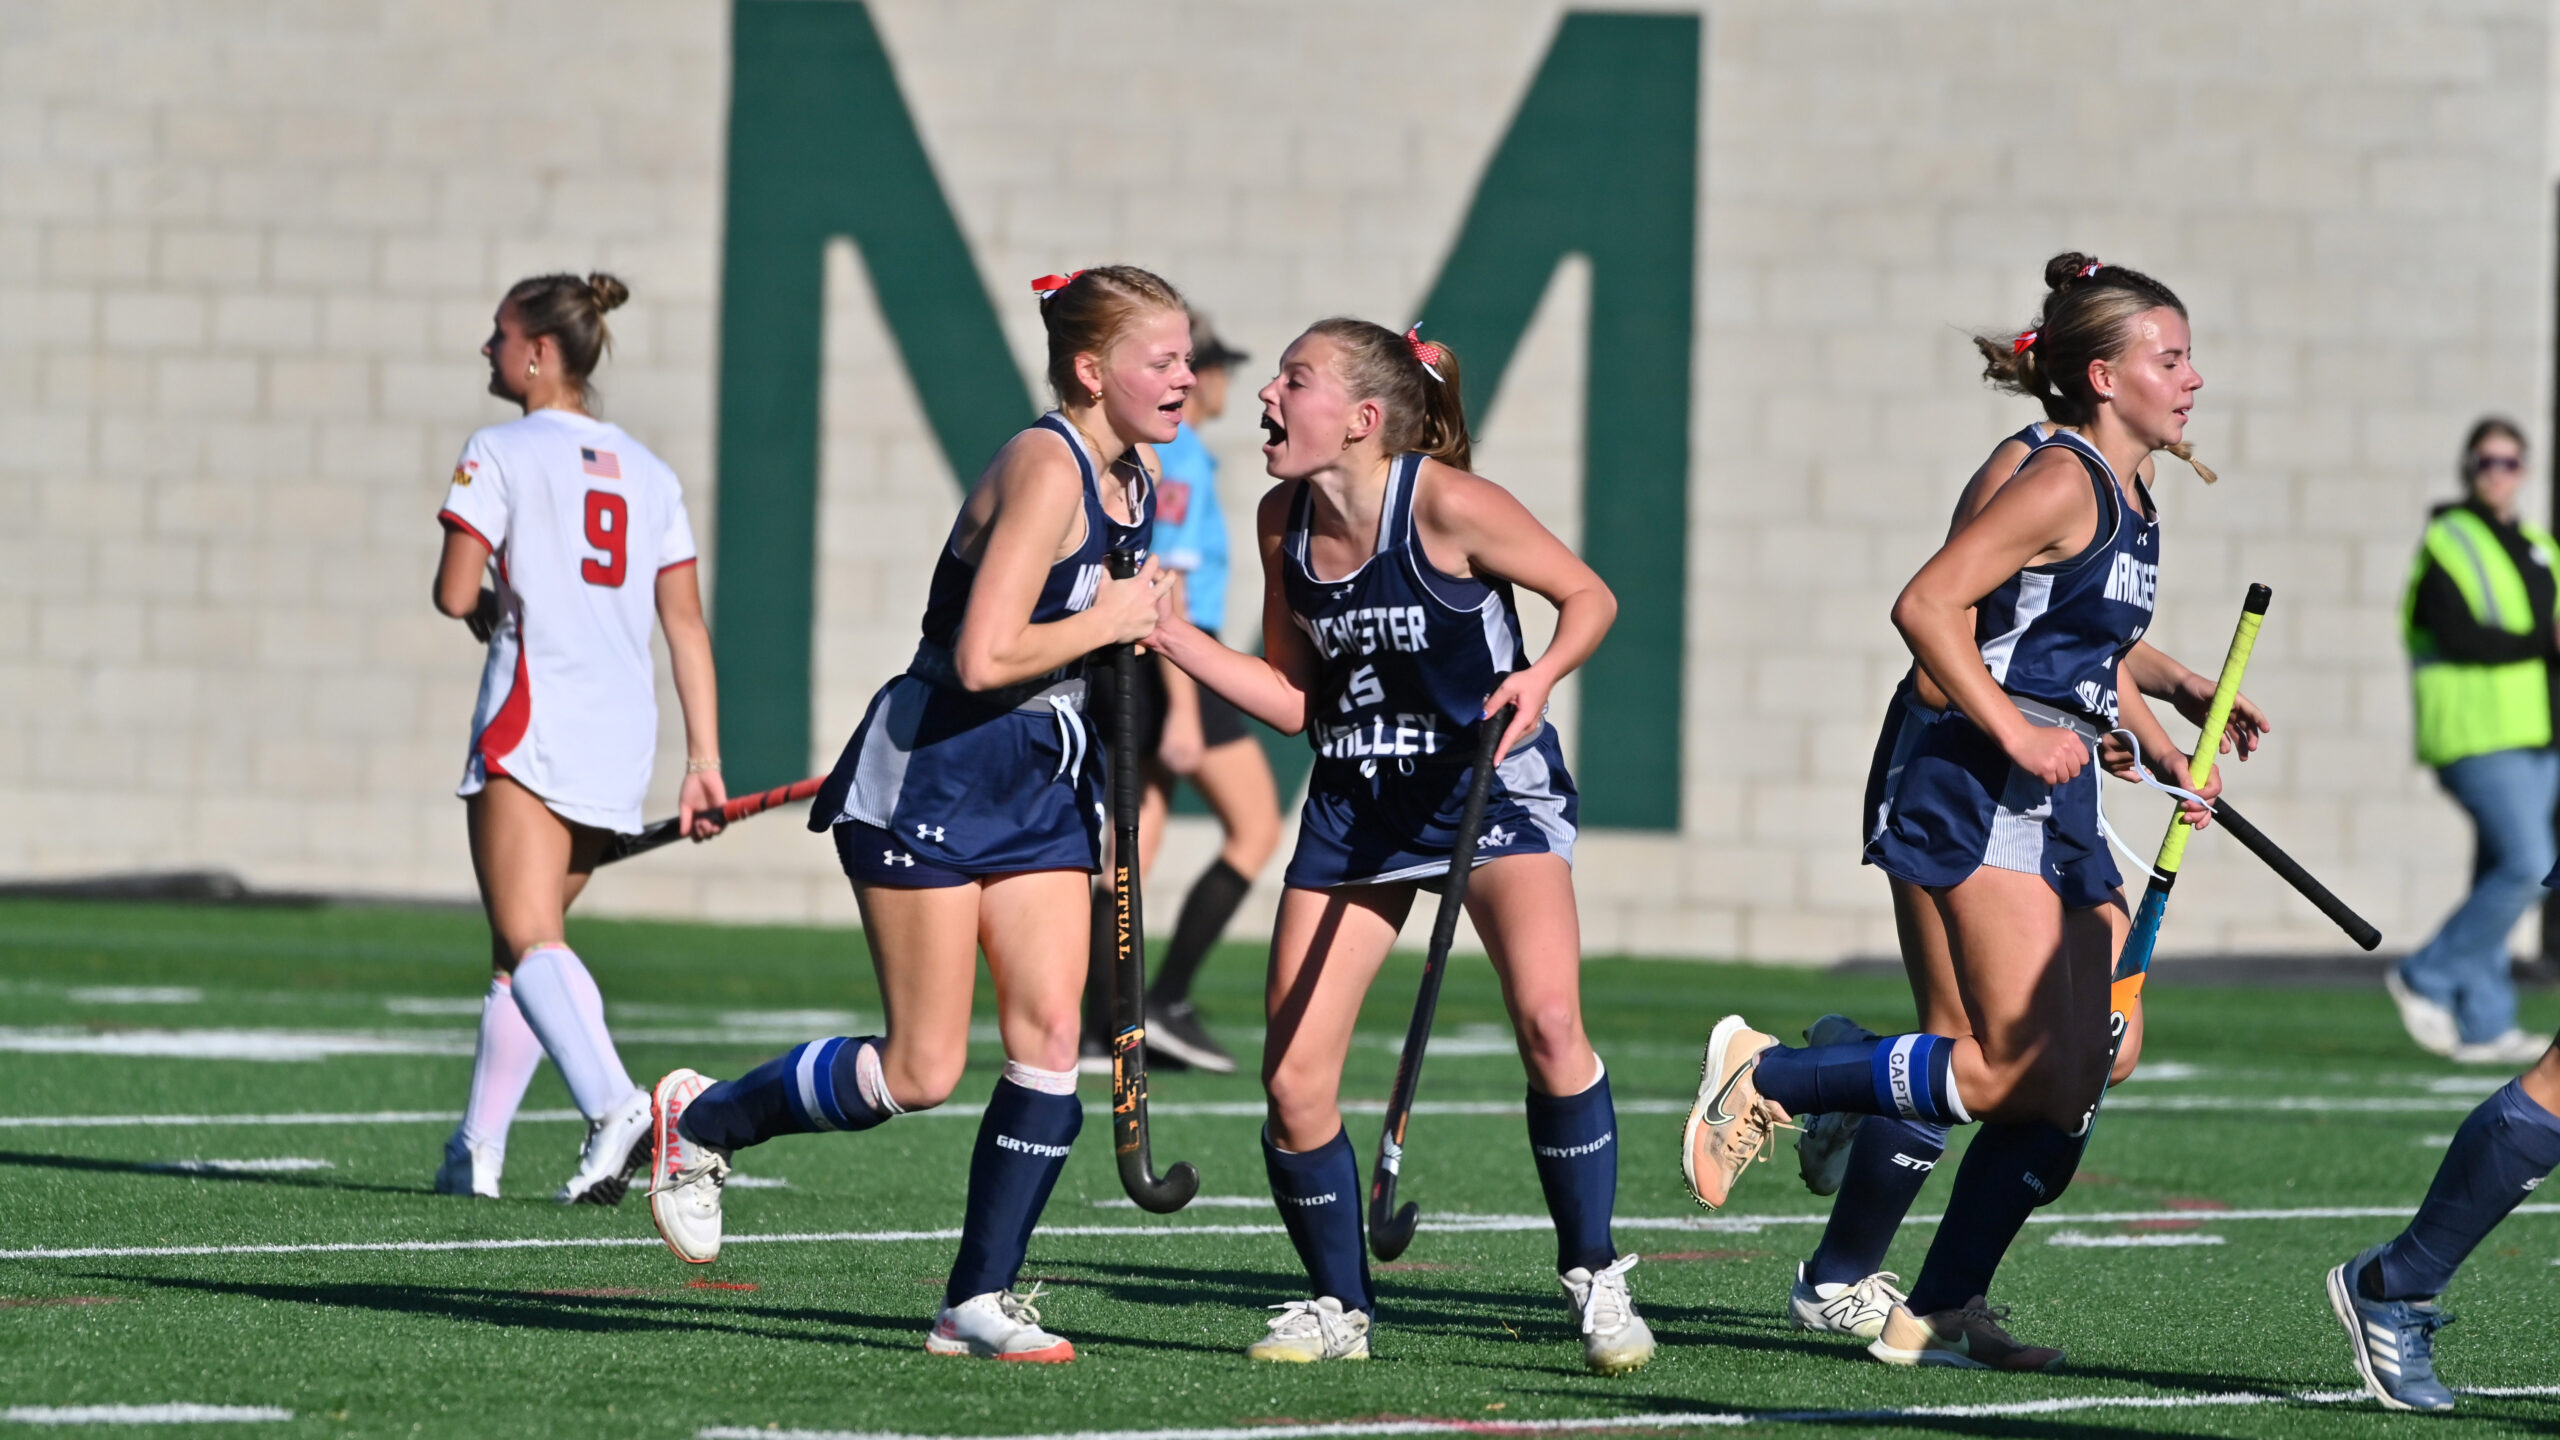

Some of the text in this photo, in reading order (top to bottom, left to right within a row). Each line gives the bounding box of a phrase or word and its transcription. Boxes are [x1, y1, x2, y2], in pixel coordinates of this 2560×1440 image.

[581, 489, 628, 588] 9
[1116, 866, 1131, 960] RITUAL
[667, 1099, 686, 1174] OSAKA
[1537, 1130, 1612, 1158] GRYPHON
